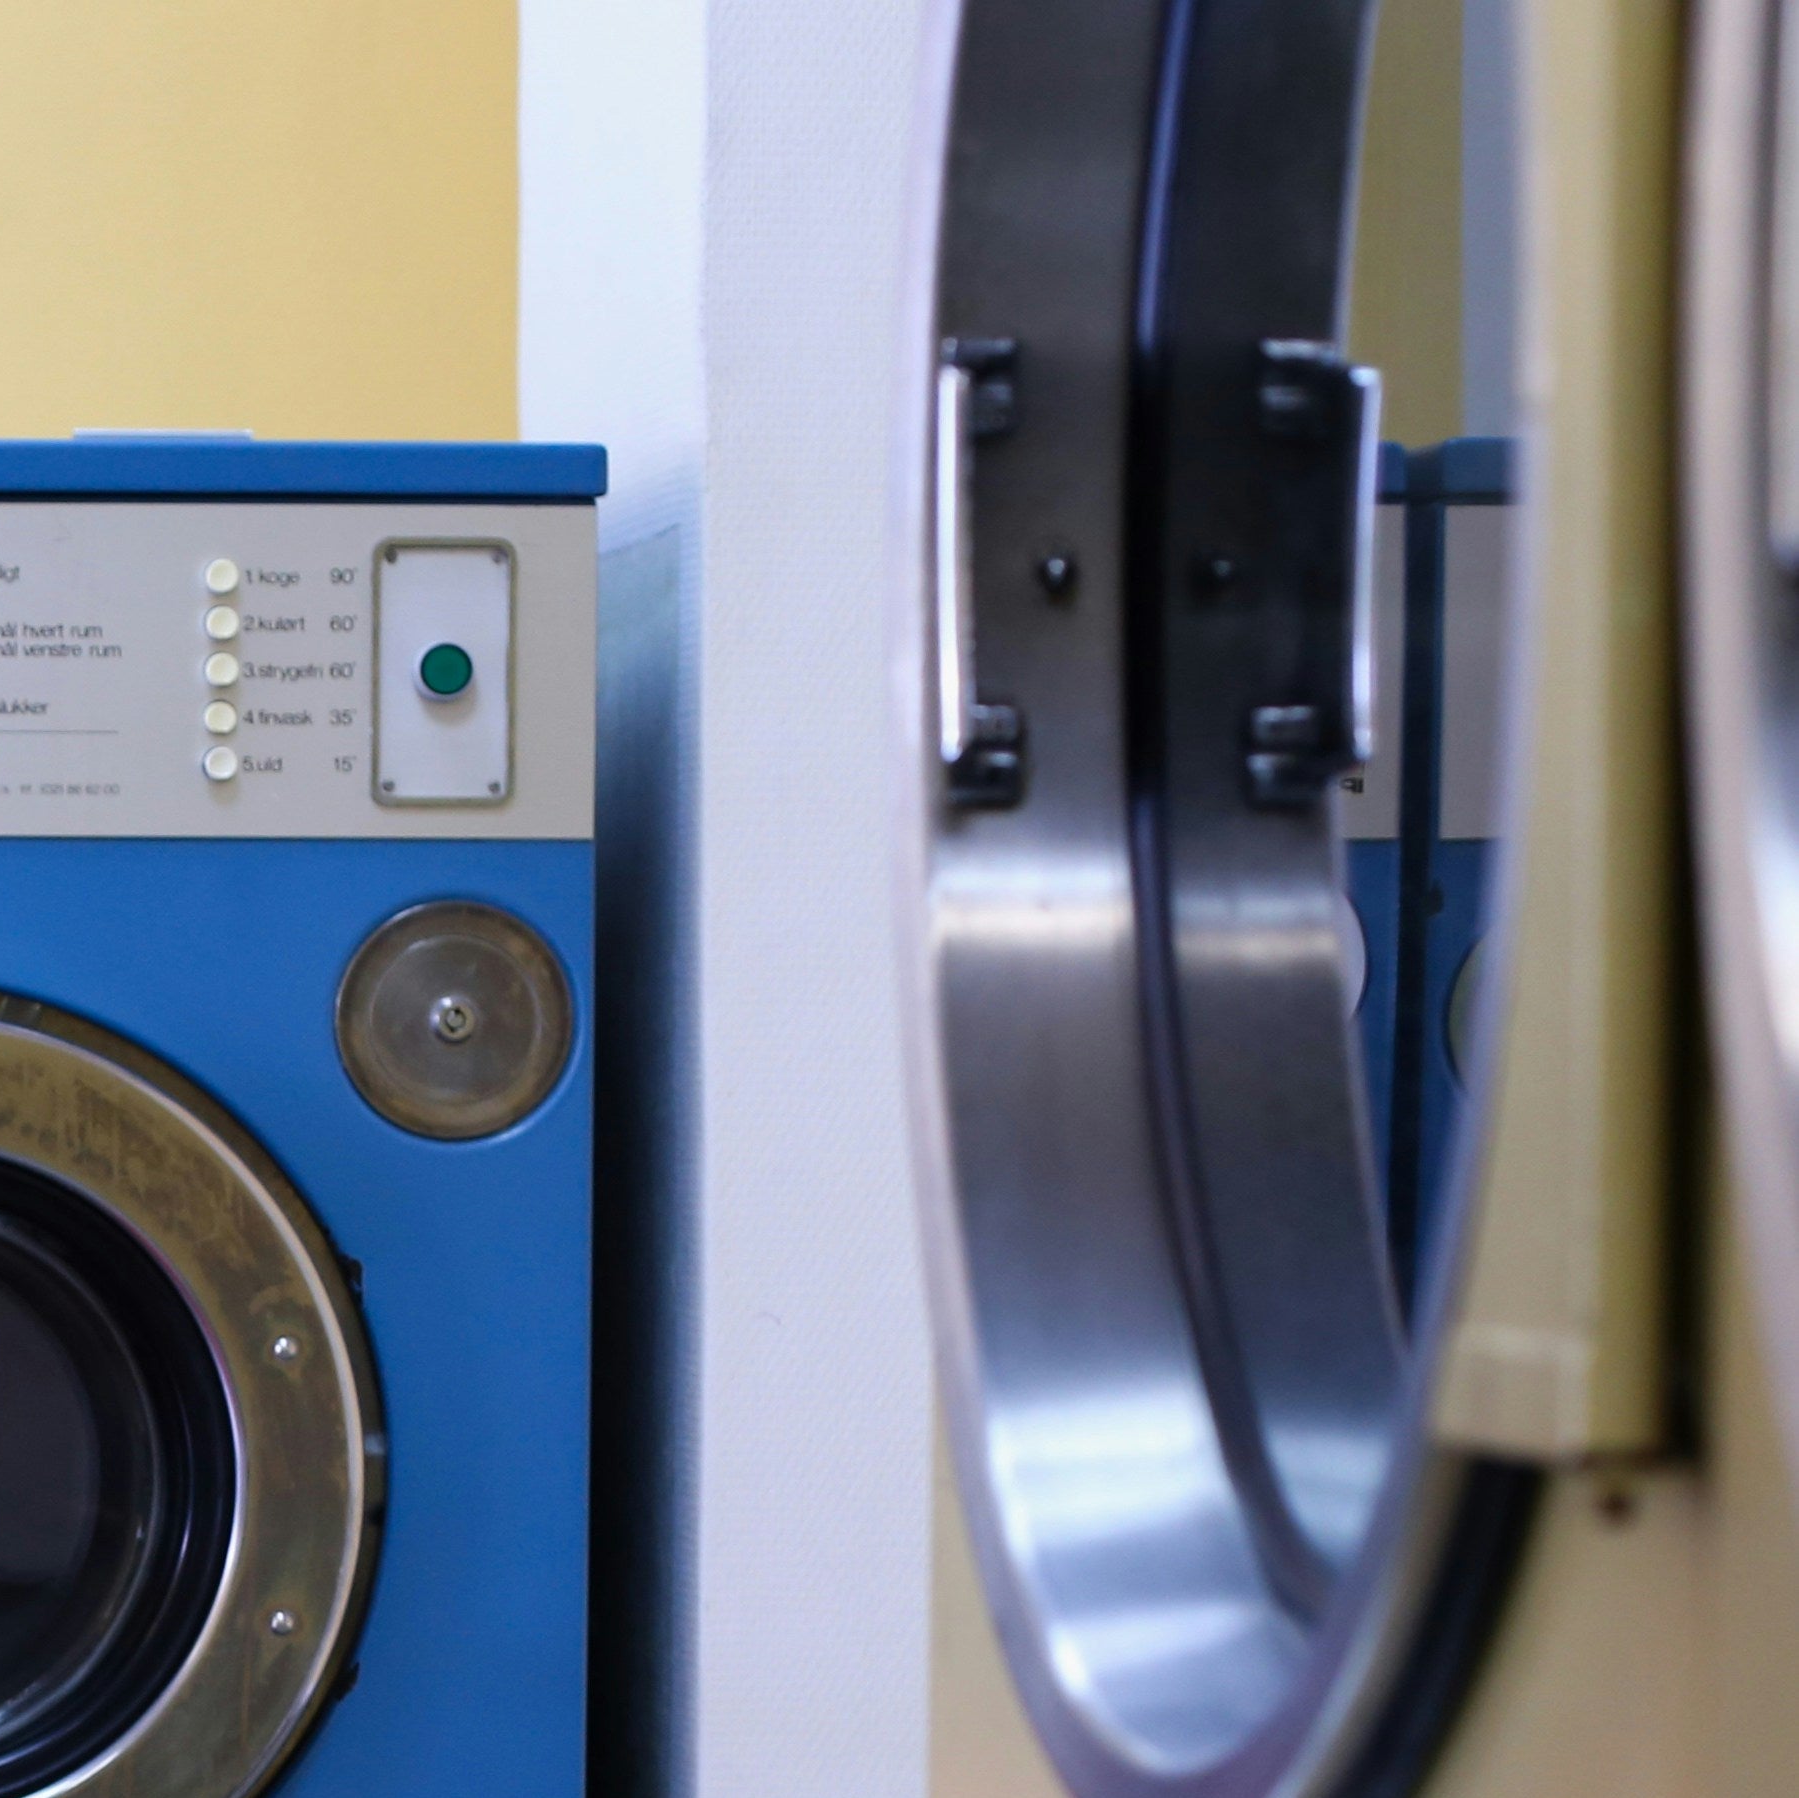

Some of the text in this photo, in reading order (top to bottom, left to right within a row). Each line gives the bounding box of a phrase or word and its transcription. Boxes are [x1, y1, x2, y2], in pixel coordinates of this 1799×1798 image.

[22, 622, 64, 636] hvert
[70, 624, 103, 636] rum
[22, 641, 83, 656] venstre
[89, 644, 122, 656] rum
